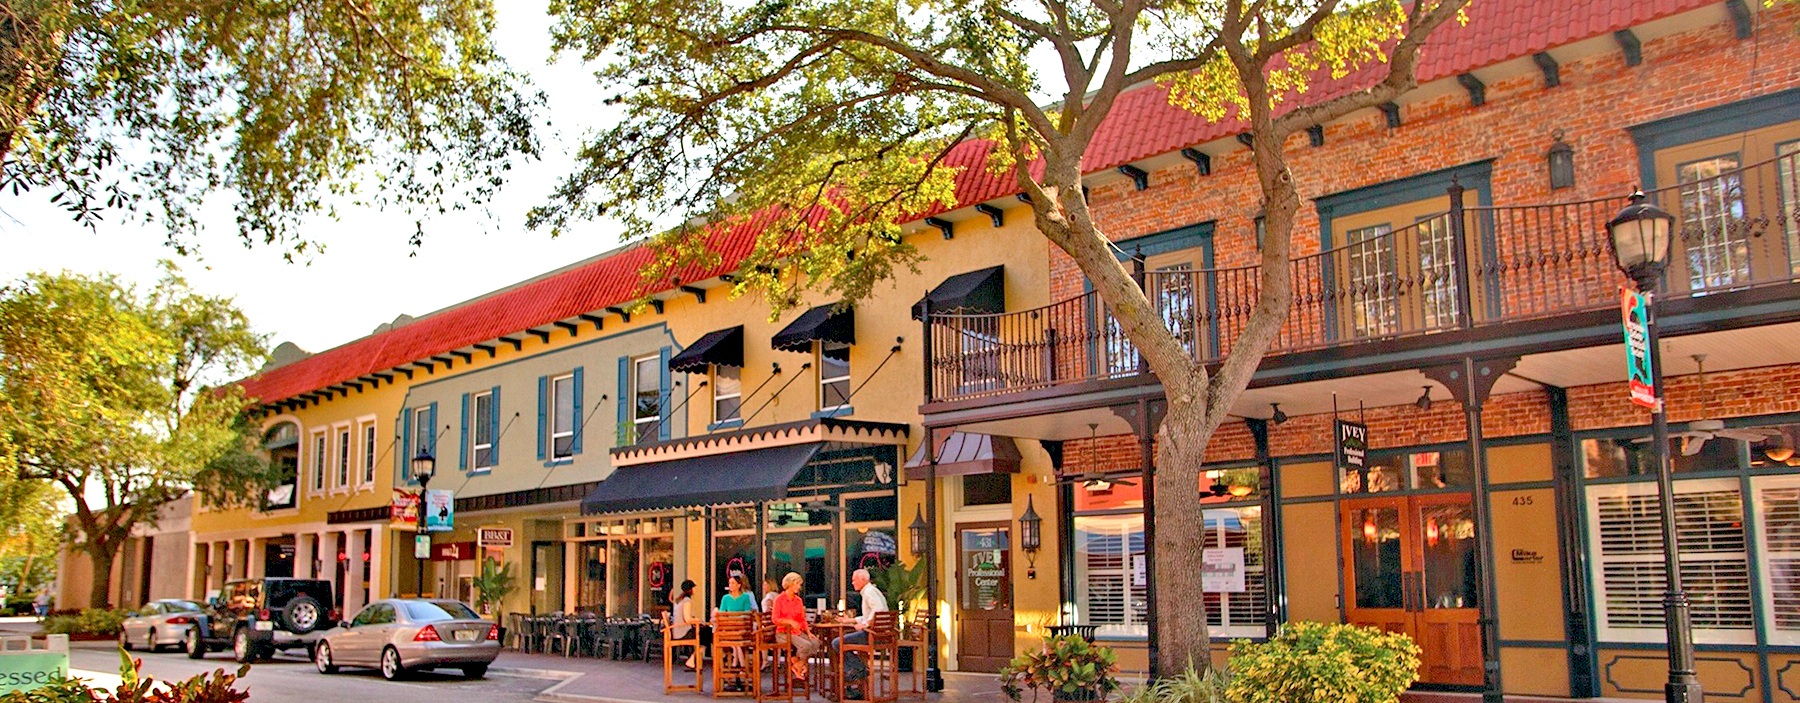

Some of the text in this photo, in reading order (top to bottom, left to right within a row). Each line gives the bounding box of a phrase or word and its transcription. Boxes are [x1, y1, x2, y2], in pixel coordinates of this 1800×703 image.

[1343, 446, 1364, 457] Professional
[1512, 496, 1533, 505] 435
[484, 531, 509, 541] BB&T
[967, 567, 1005, 577] Professional
[975, 577, 998, 586] Center
